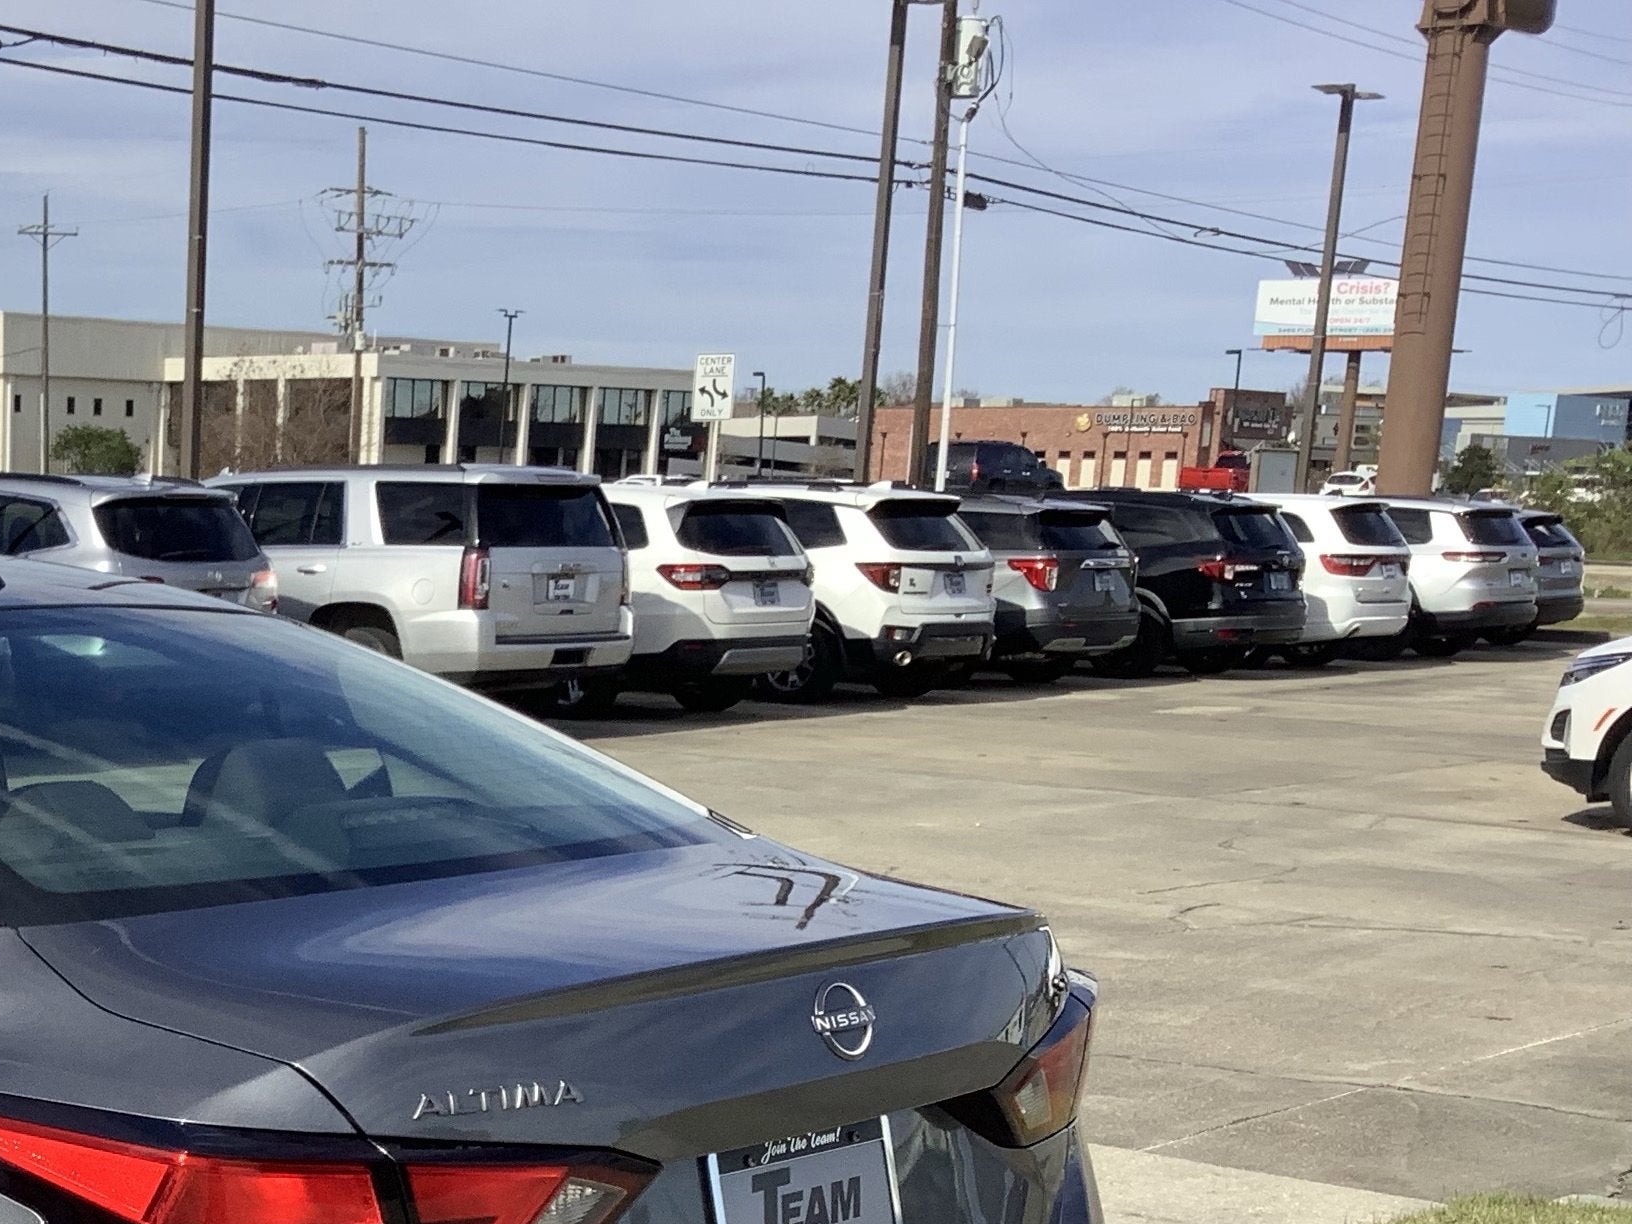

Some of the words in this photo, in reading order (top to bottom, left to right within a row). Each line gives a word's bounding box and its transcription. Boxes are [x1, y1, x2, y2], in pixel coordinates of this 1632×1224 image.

[1336, 282, 1390, 295] Crisis?
[1269, 297, 1305, 305] Mental
[1358, 296, 1395, 305] Substa
[699, 356, 732, 366] CENTER
[704, 366, 727, 376] LANE
[700, 408, 724, 417] ONLY
[1096, 413, 1157, 425] DUMPING
[1160, 413, 1169, 425] &
[815, 1009, 875, 1031] NISSAN
[413, 1080, 585, 1120] ALTIMA
[761, 1140, 787, 1165] Join
